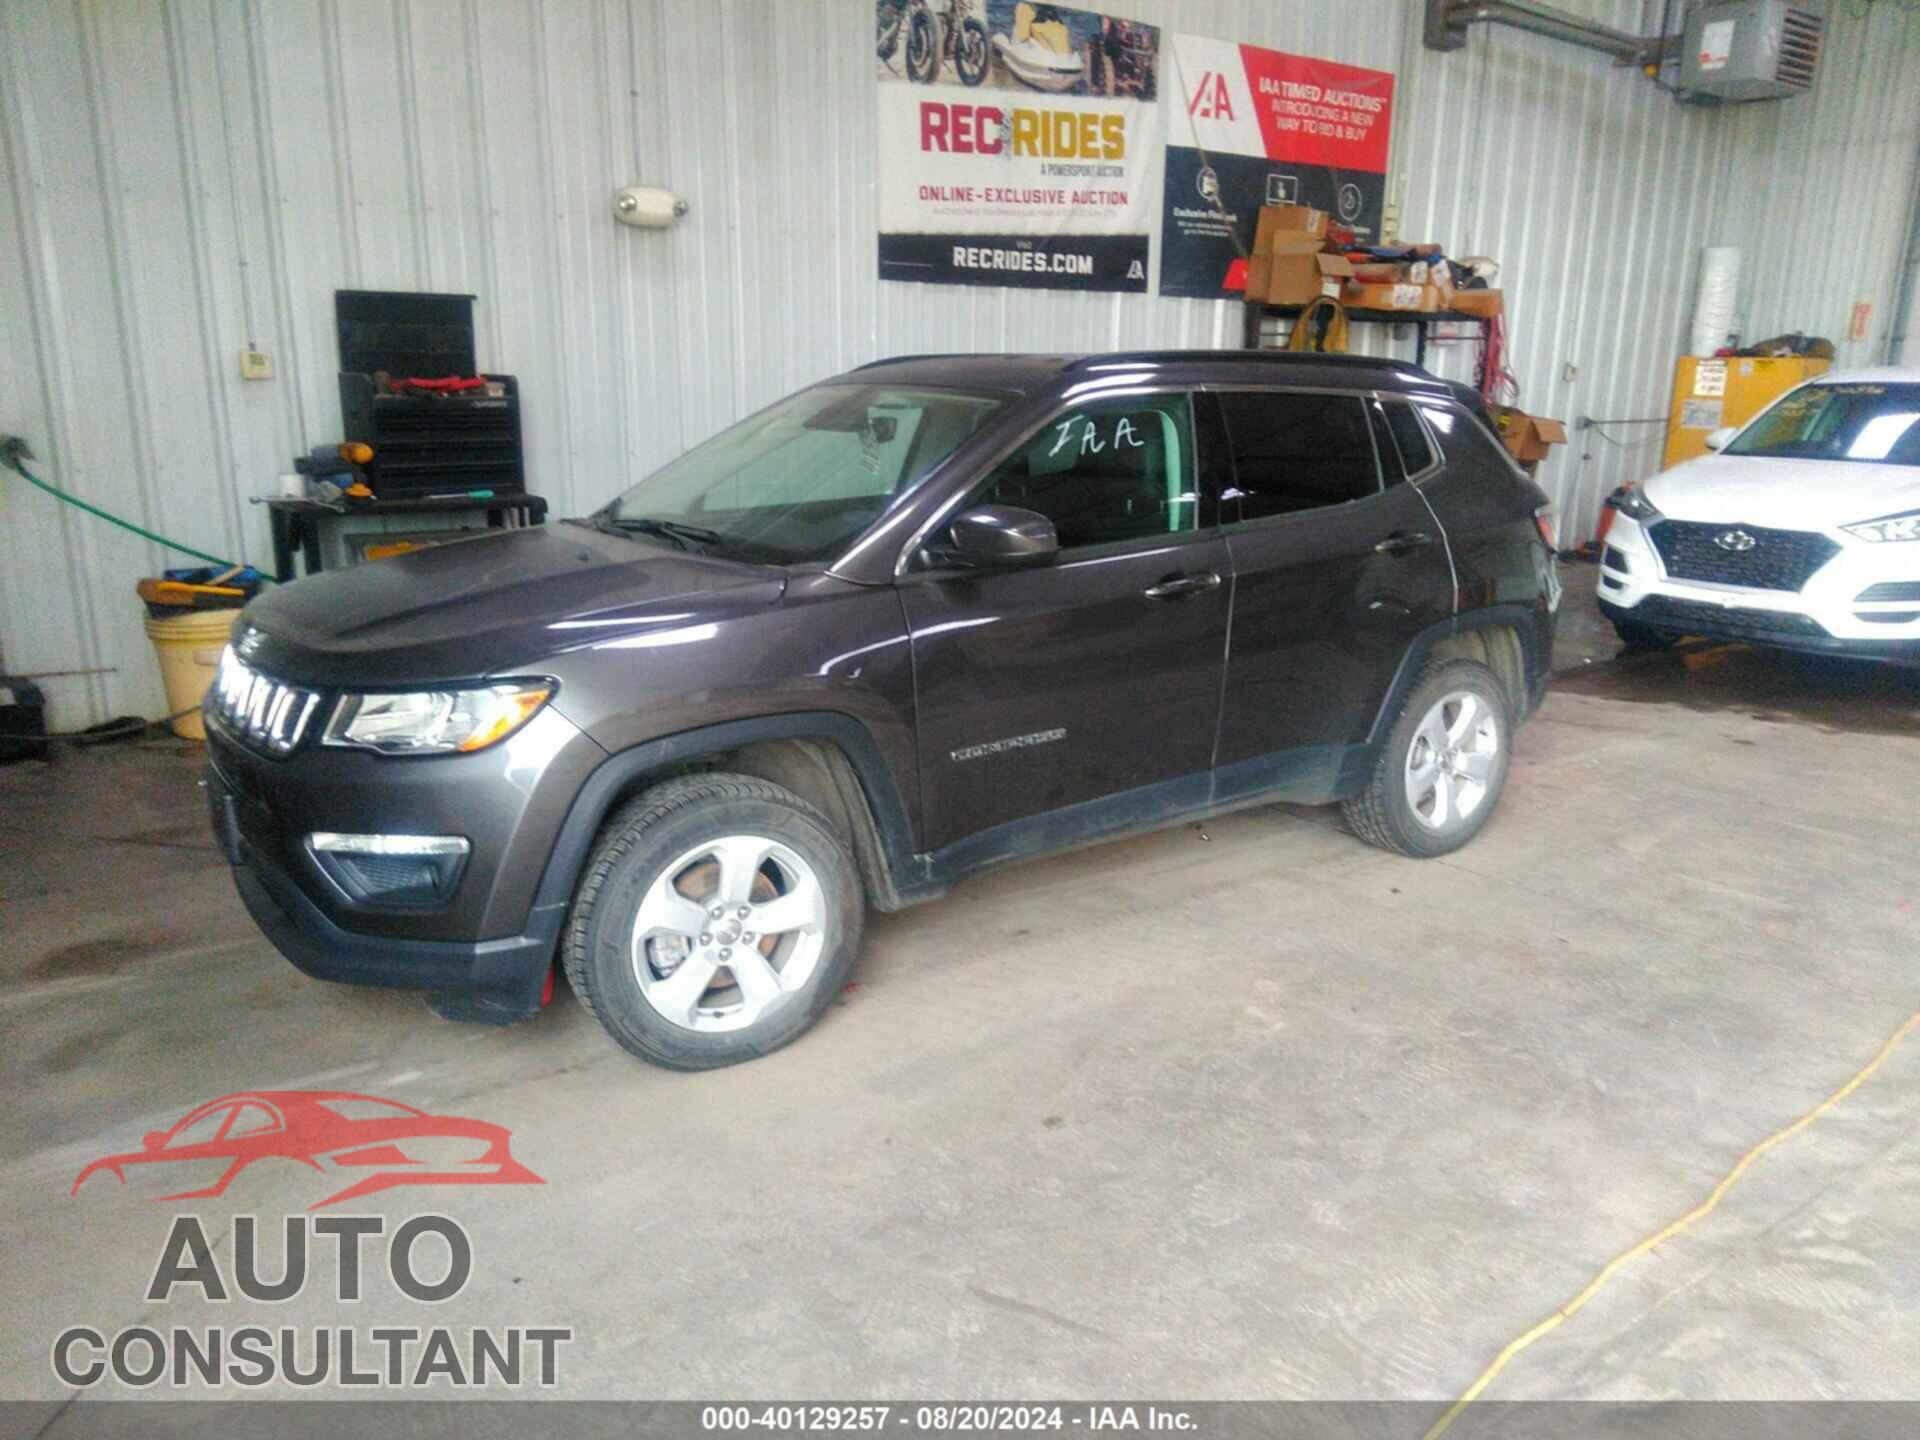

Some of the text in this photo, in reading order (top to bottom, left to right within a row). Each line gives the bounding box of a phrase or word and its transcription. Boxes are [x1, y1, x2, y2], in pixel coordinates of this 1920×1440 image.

[1280, 81, 1321, 102] TIMED
[919, 101, 1126, 160] REC RIDES
[919, 185, 1128, 205] ONLINE-EXCLUSIVE AUCTION
[953, 246, 1094, 275] RECRIDES.COM
